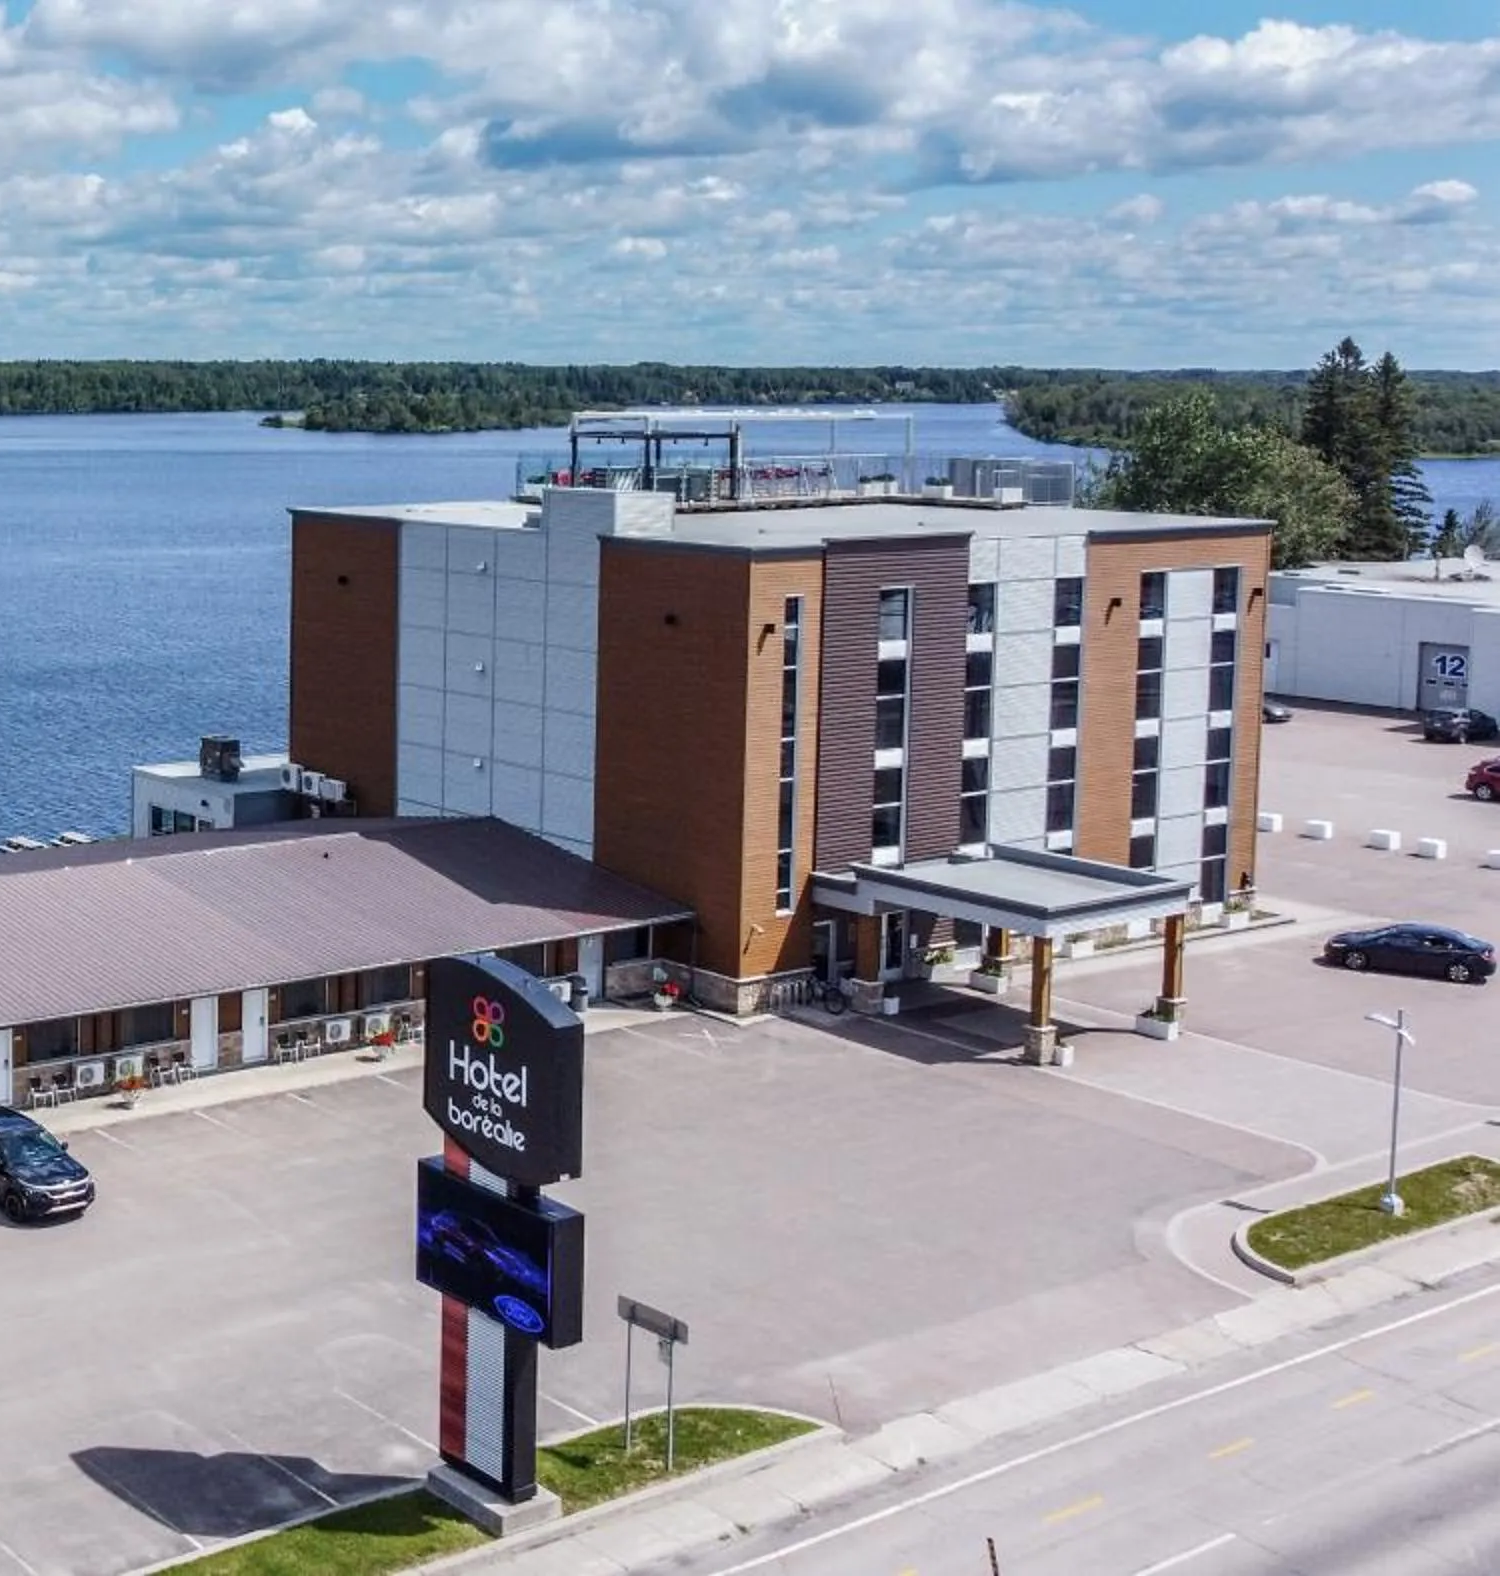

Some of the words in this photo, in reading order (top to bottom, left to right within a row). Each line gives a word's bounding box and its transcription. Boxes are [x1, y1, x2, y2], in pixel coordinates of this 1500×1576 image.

[1435, 655, 1465, 676] 12
[450, 1039, 527, 1107] Hotel
[472, 1092, 489, 1111] de
[490, 1097, 503, 1117] la
